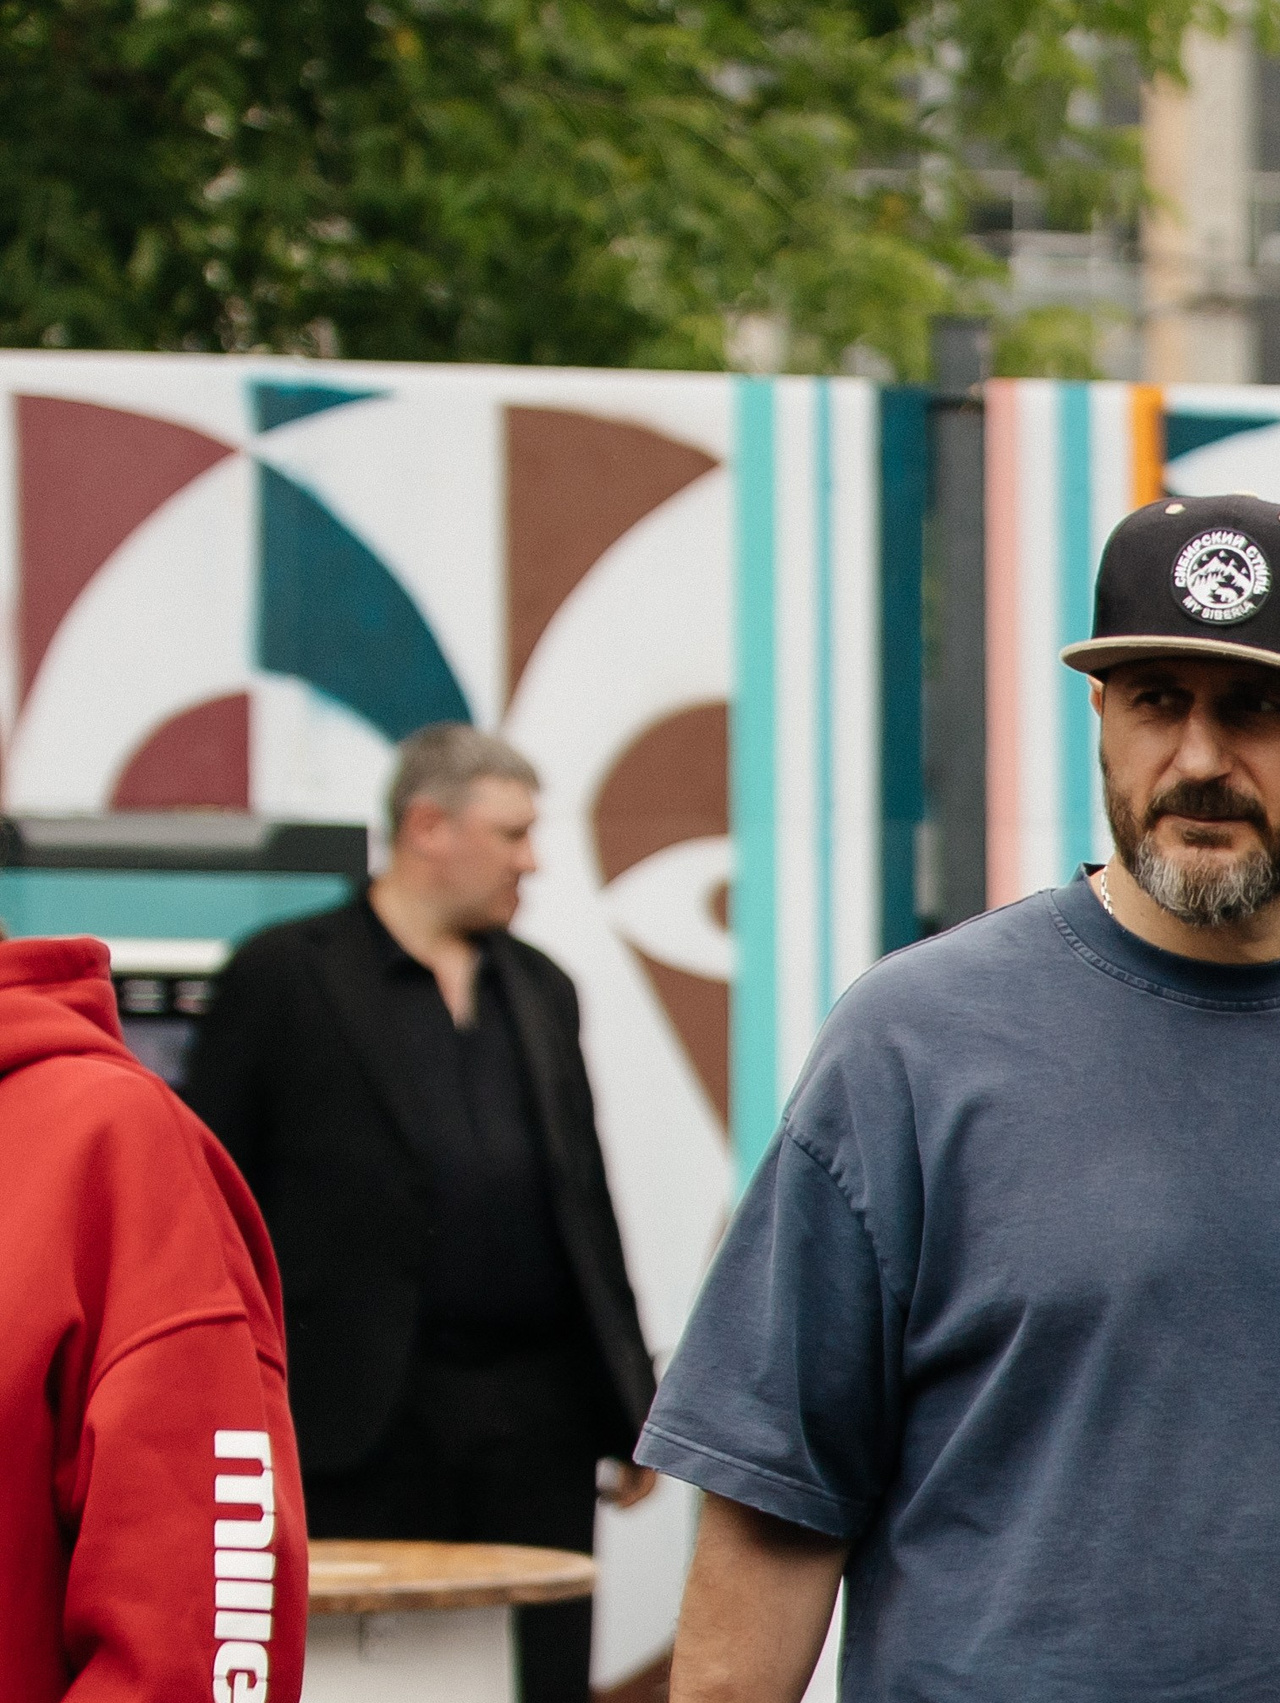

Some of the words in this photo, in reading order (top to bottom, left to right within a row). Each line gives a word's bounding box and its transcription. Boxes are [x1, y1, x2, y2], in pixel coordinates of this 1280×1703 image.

[1174, 530, 1248, 588] СИБИРСКИЙ
[1245, 544, 1271, 595] СТИЛЬ
[1182, 595, 1203, 614] MY
[1201, 600, 1258, 621] SIBERIA
